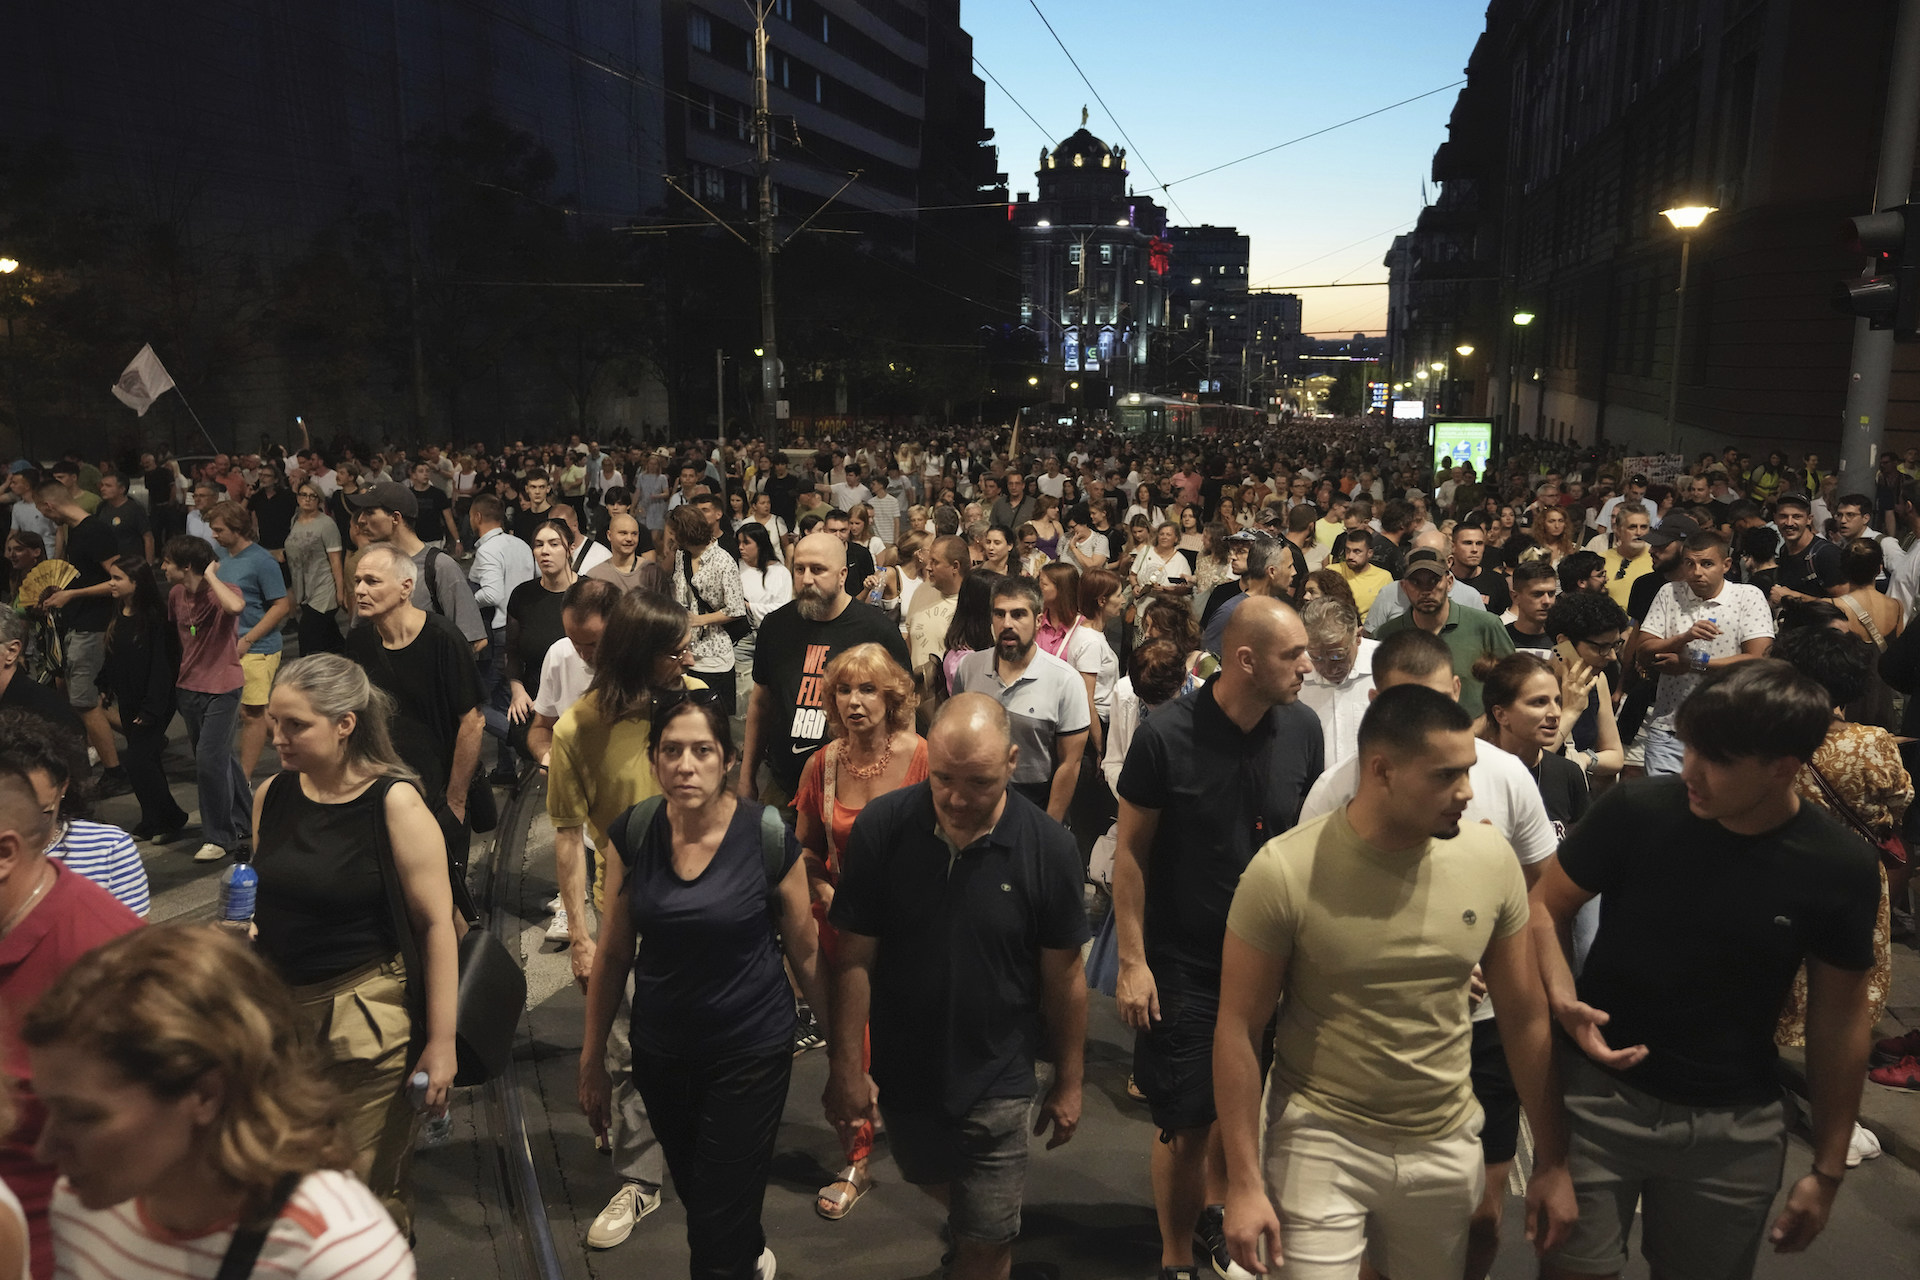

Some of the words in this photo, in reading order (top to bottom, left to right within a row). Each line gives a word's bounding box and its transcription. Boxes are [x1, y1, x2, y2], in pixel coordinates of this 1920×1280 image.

[915, 623, 929, 648] NEW
[802, 644, 831, 675] WE
[790, 707, 828, 740] BGD
